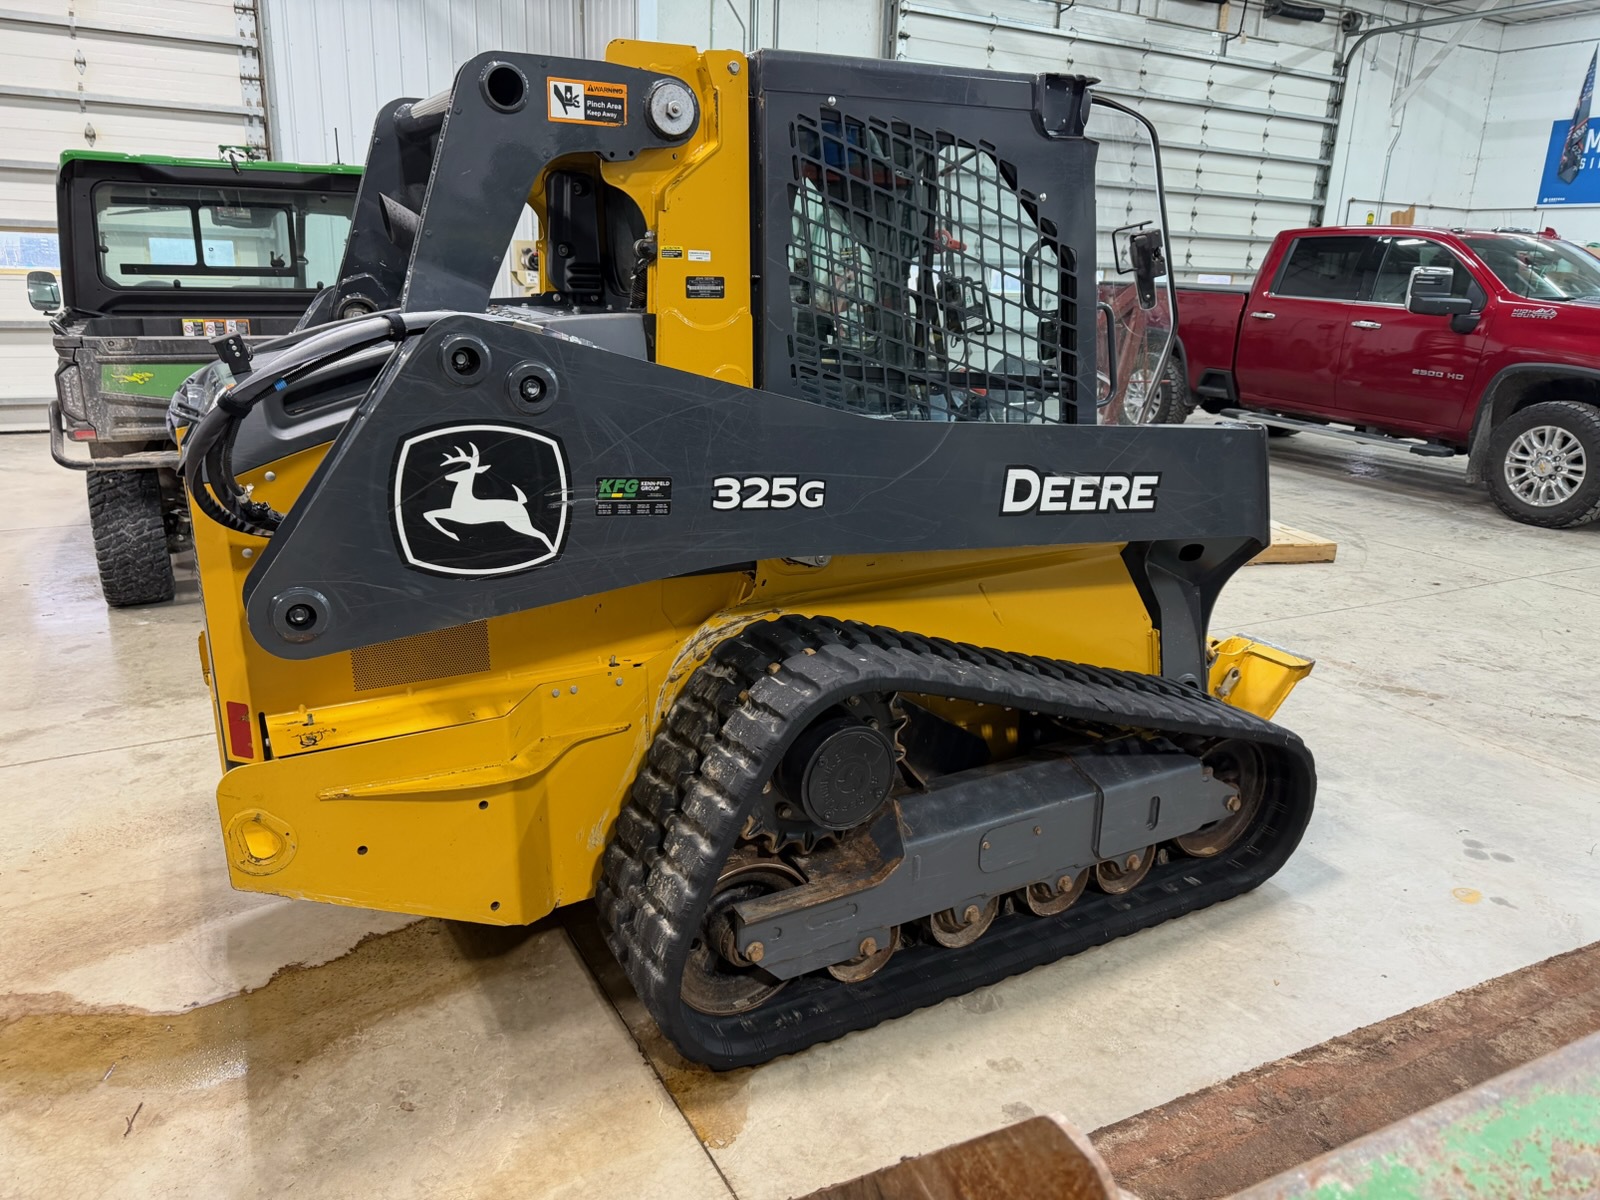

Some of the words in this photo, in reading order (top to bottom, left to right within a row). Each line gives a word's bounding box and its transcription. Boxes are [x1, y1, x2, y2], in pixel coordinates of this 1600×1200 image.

[594, 86, 624, 95] WARNING
[586, 100, 606, 109] Pinch
[606, 102, 622, 110] Area
[602, 111, 618, 119] Away
[1510, 312, 1554, 320] COUNTRY
[1447, 372, 1465, 381] HD
[600, 479, 639, 493] KFG
[1002, 468, 1159, 512] DEERE
[712, 477, 825, 510] 325G
